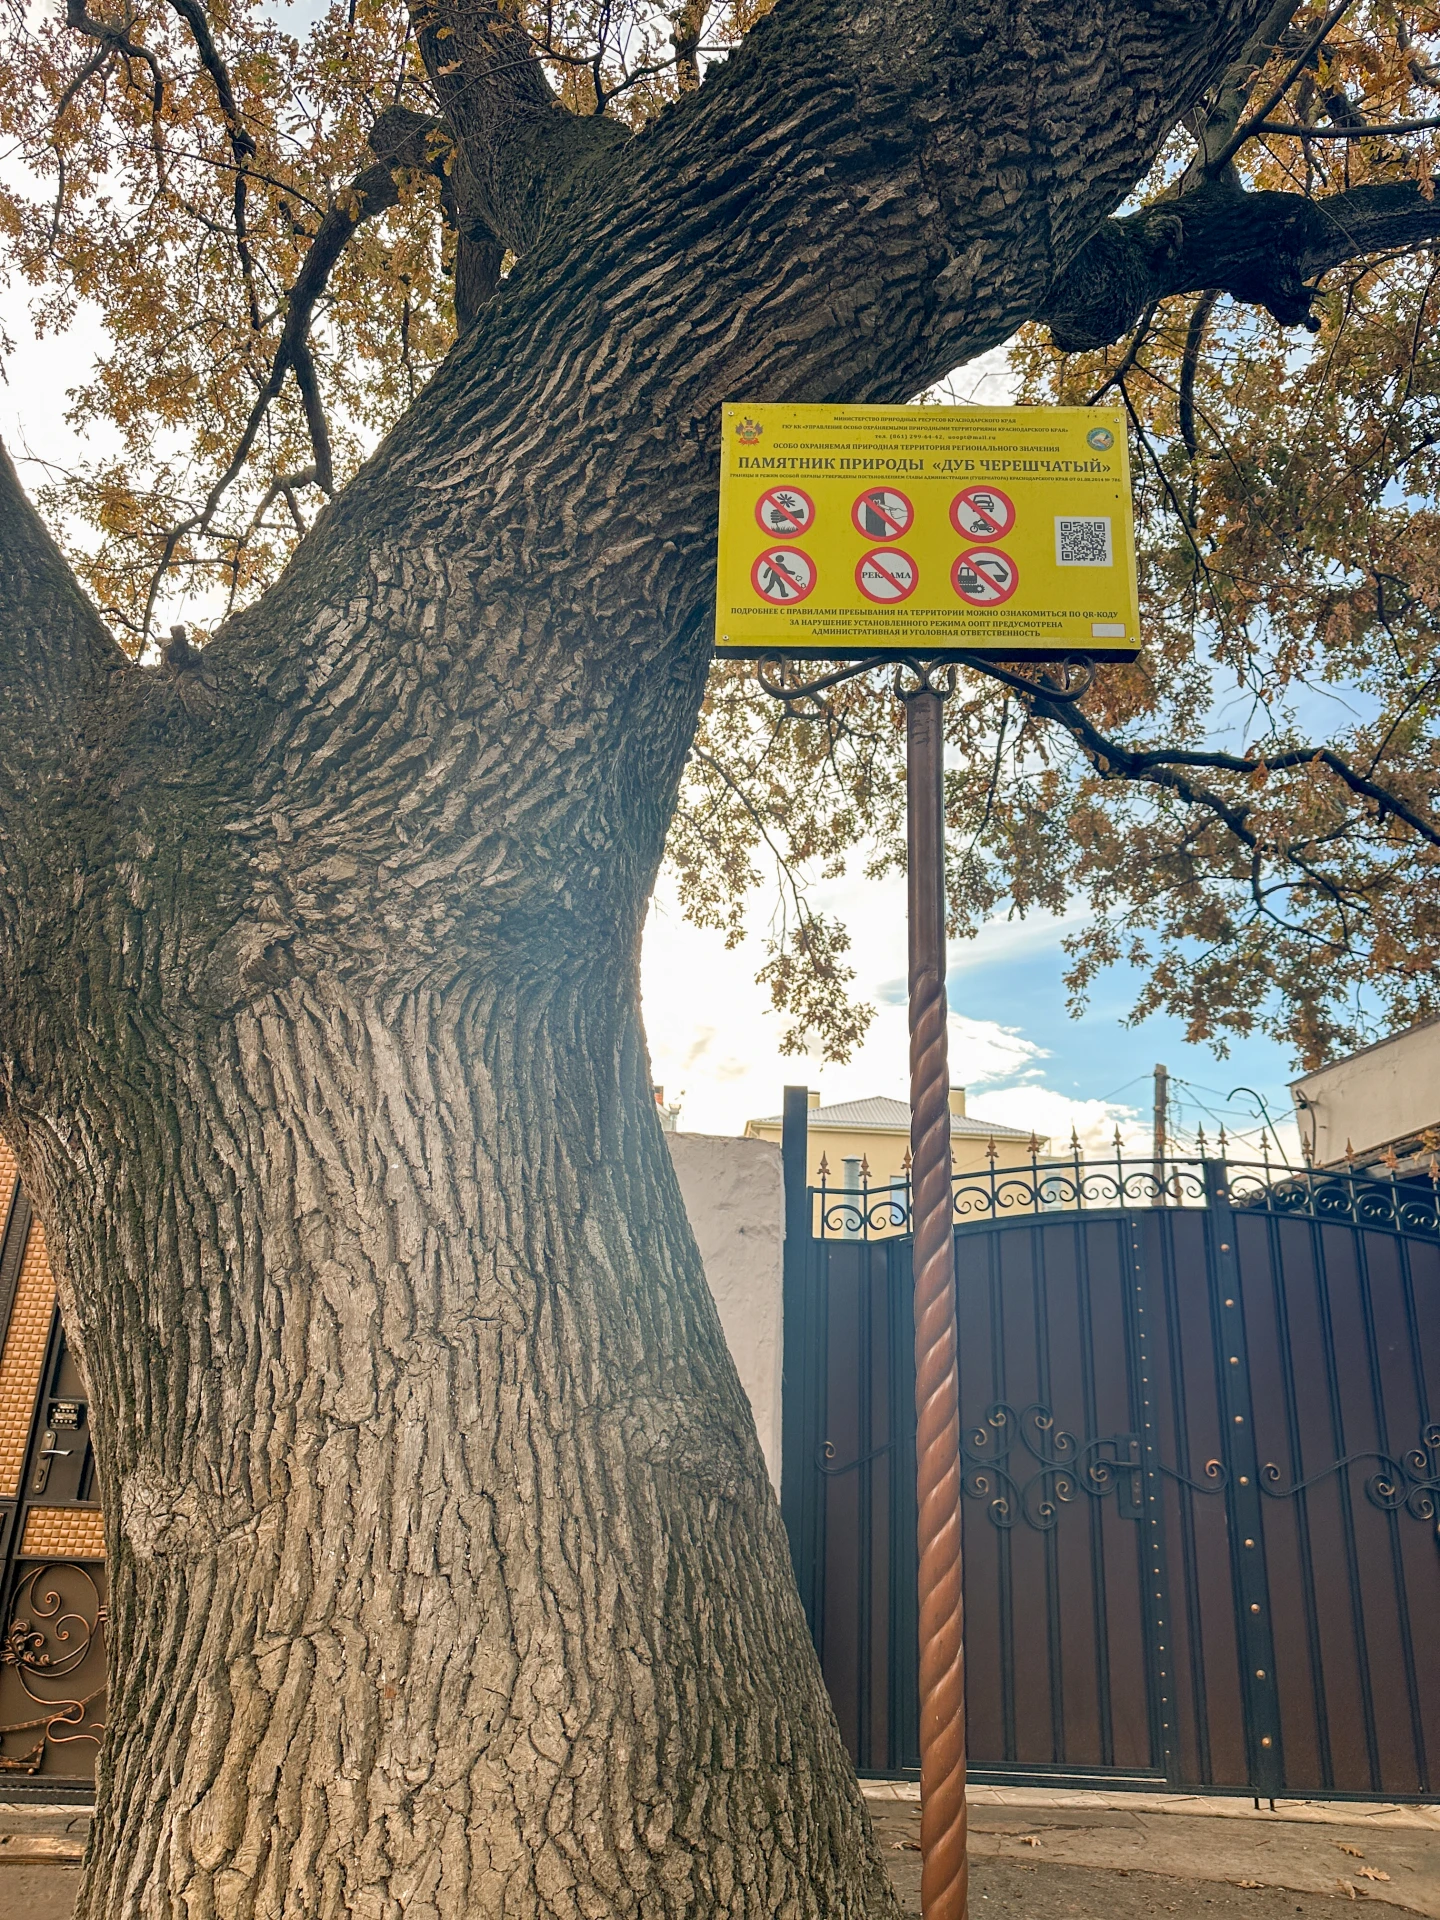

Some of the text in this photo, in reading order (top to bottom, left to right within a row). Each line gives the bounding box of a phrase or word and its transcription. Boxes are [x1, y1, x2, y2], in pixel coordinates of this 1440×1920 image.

[738, 457, 1111, 473] ПАМЯТНИК ПРИРОДЫ «ДУБ ЧЕРЕШЧАТЫЙ»
